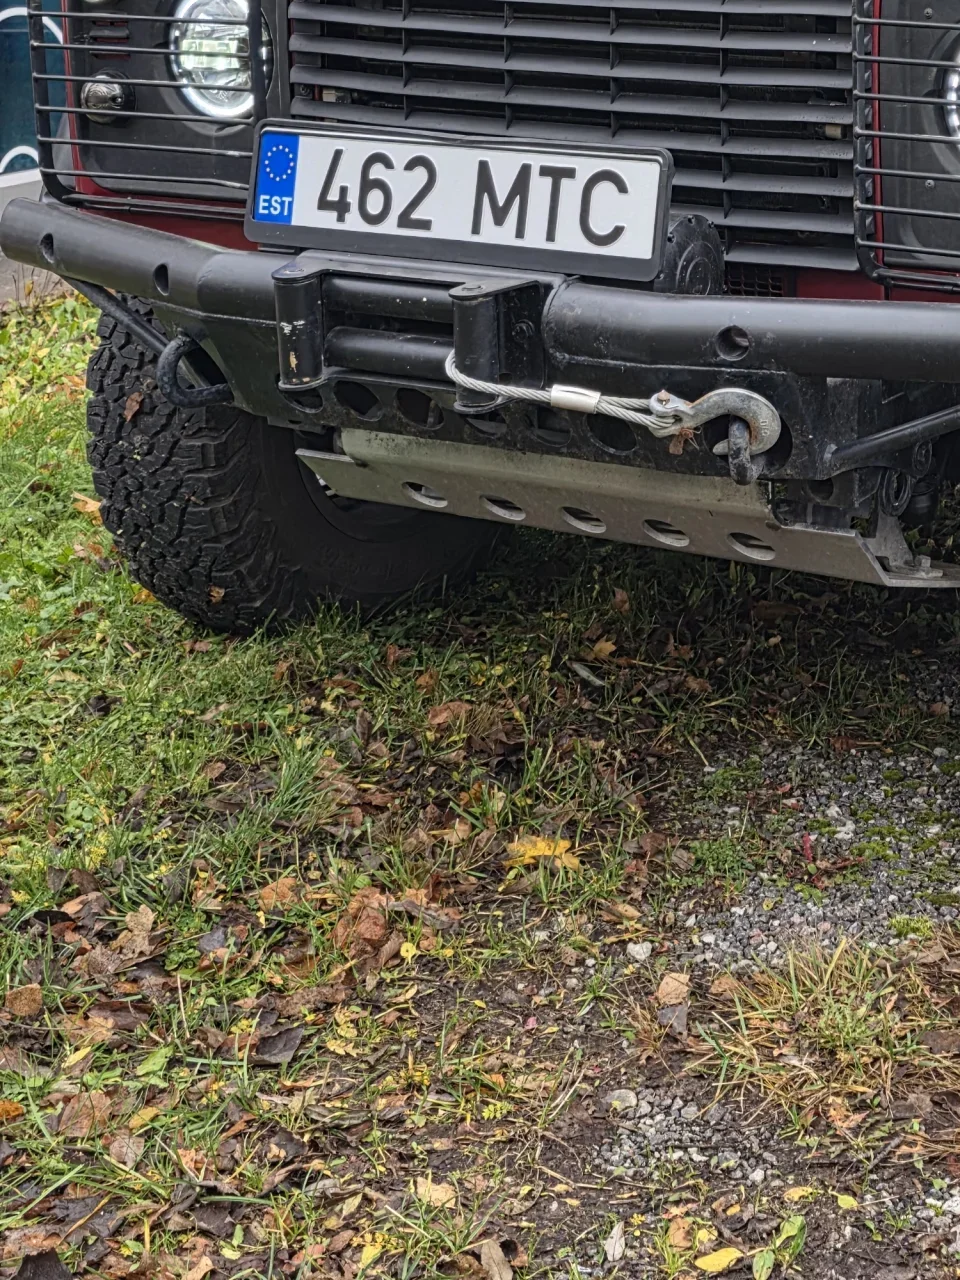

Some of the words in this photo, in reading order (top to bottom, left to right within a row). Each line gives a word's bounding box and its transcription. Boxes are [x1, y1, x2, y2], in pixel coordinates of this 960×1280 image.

[258, 194, 293, 216] EST
[317, 148, 438, 232] 462
[470, 158, 631, 247] MTC
